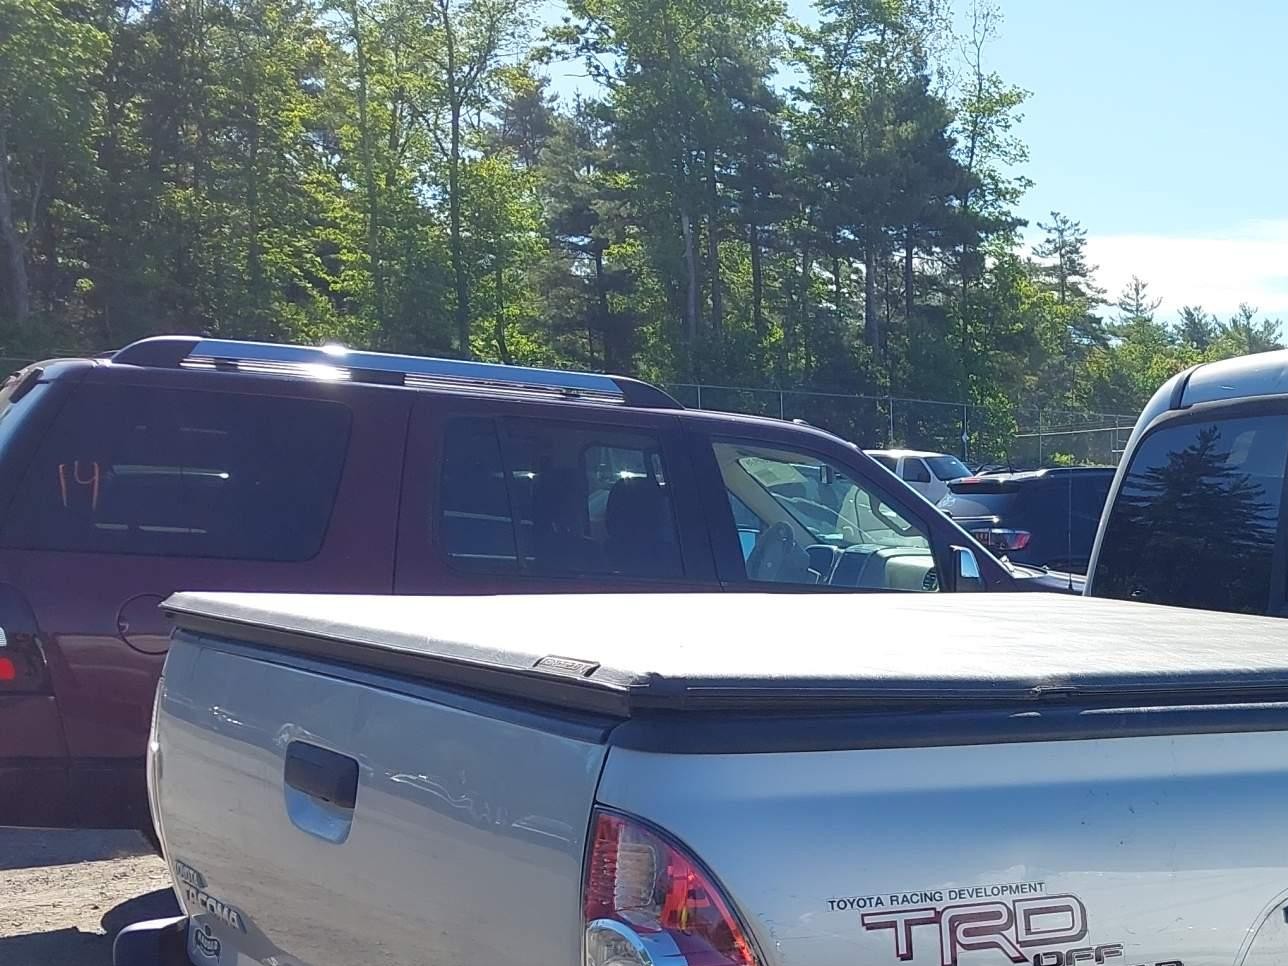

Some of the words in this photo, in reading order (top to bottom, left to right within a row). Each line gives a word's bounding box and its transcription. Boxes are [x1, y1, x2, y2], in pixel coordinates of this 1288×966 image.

[58, 460, 99, 512] 14
[828, 896, 885, 911] TOYOTA
[890, 890, 944, 906] RACING
[948, 882, 1045, 901] DEVELOPMENT
